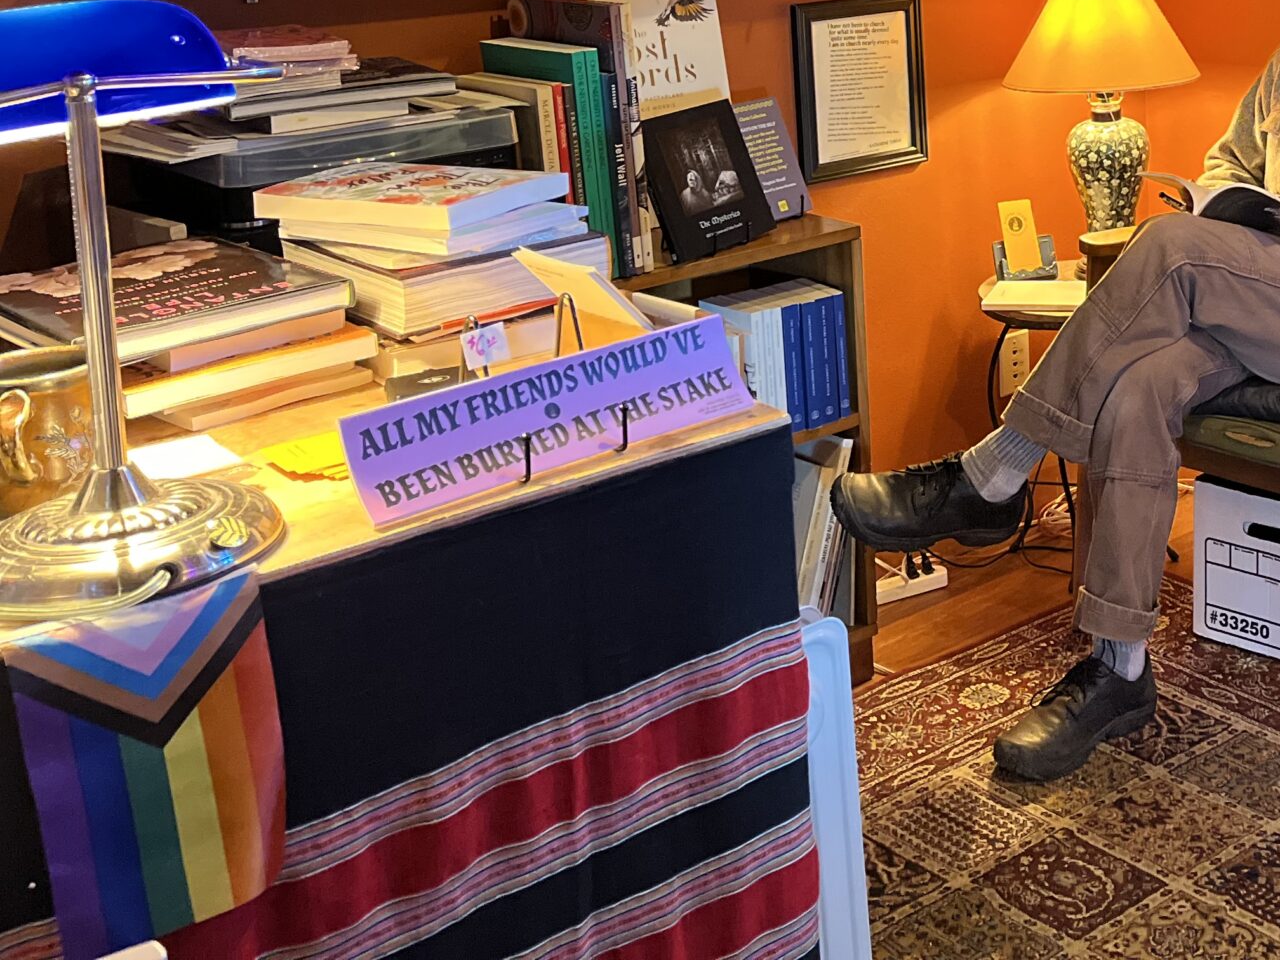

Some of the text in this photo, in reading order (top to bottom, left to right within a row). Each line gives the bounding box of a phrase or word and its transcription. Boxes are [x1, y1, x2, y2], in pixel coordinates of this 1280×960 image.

[542, 99, 551, 136] MARCEL
[615, 143, 627, 187] Jeff Wall
[712, 210, 741, 224] Mysteries
[358, 324, 706, 460] ALL MY FRIENDS WOULD'VE
[375, 367, 733, 508] BEEN BURNED AT THE STAKE
[1210, 610, 1270, 639] #33250
